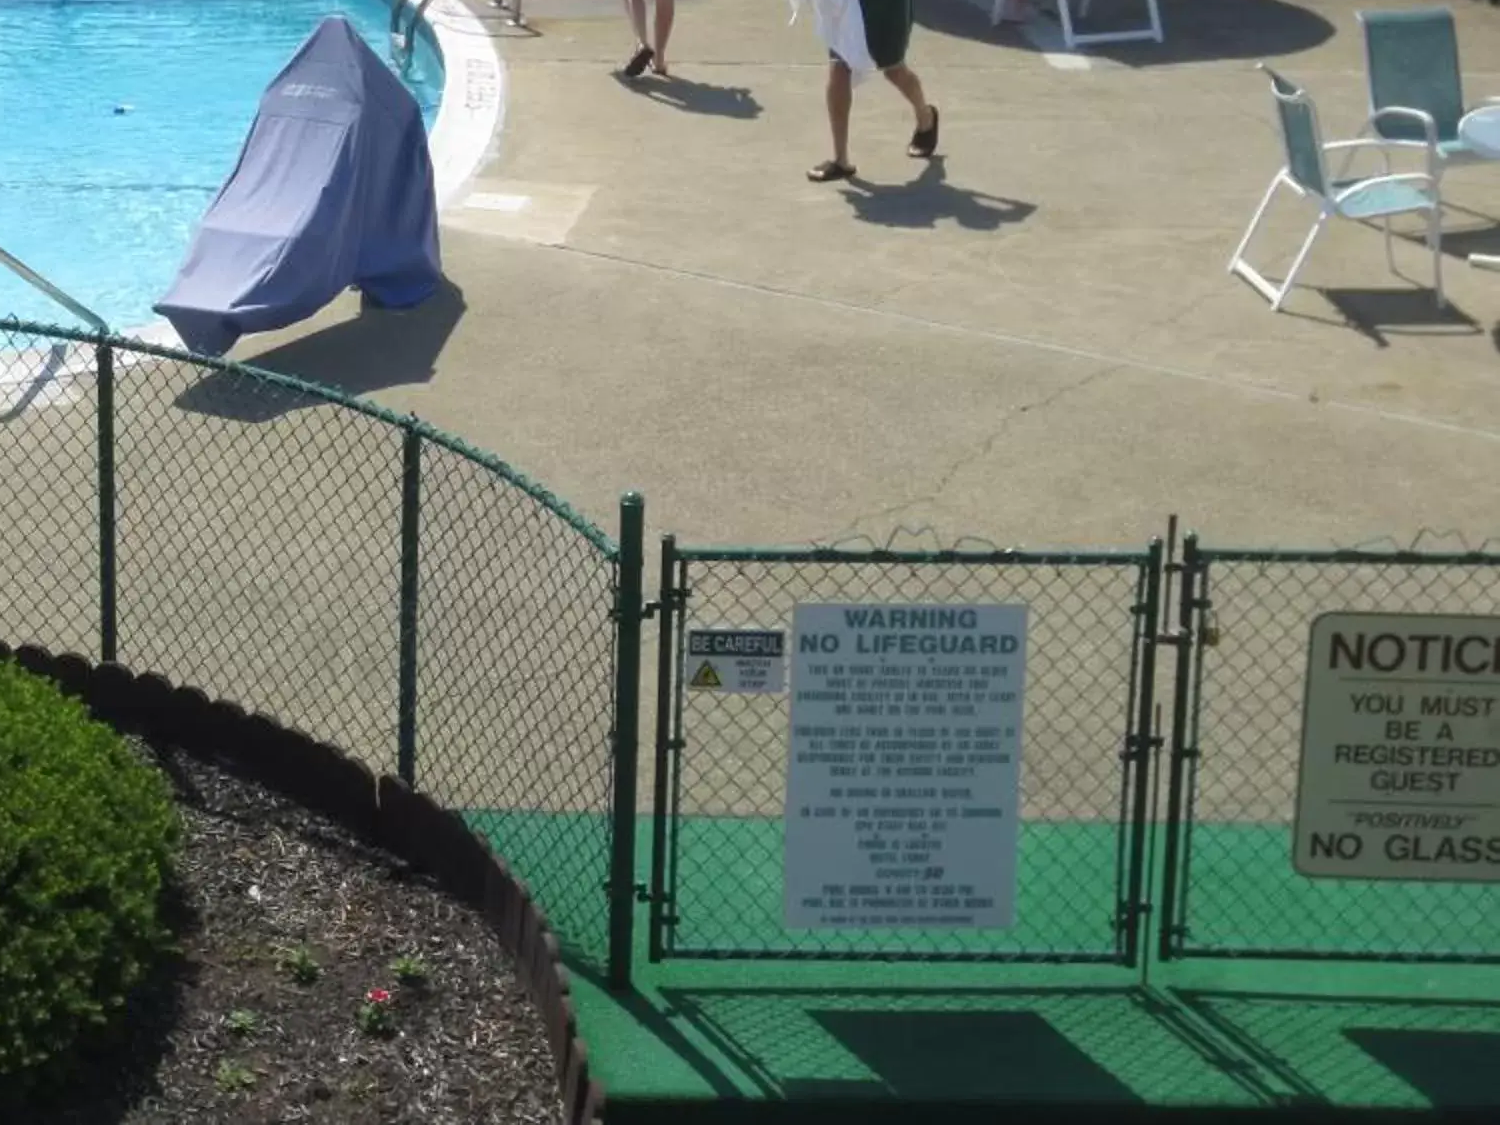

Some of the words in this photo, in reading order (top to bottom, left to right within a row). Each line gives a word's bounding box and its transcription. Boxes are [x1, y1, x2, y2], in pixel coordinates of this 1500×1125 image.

[843, 609, 978, 630] WARNING
[691, 635, 710, 652] BE
[713, 635, 781, 653] CAREFUL
[799, 634, 840, 654] NO
[855, 634, 1019, 655] LIFEGUARD
[1350, 693, 1404, 716] YOU
[1420, 695, 1497, 717] MUST
[1385, 720, 1422, 741] BE
[1436, 721, 1454, 742] A
[1334, 745, 1500, 768] REGISTERED
[1369, 771, 1462, 793] GUEST
[1309, 832, 1363, 860] NO
[1384, 833, 1500, 864] GLASS
